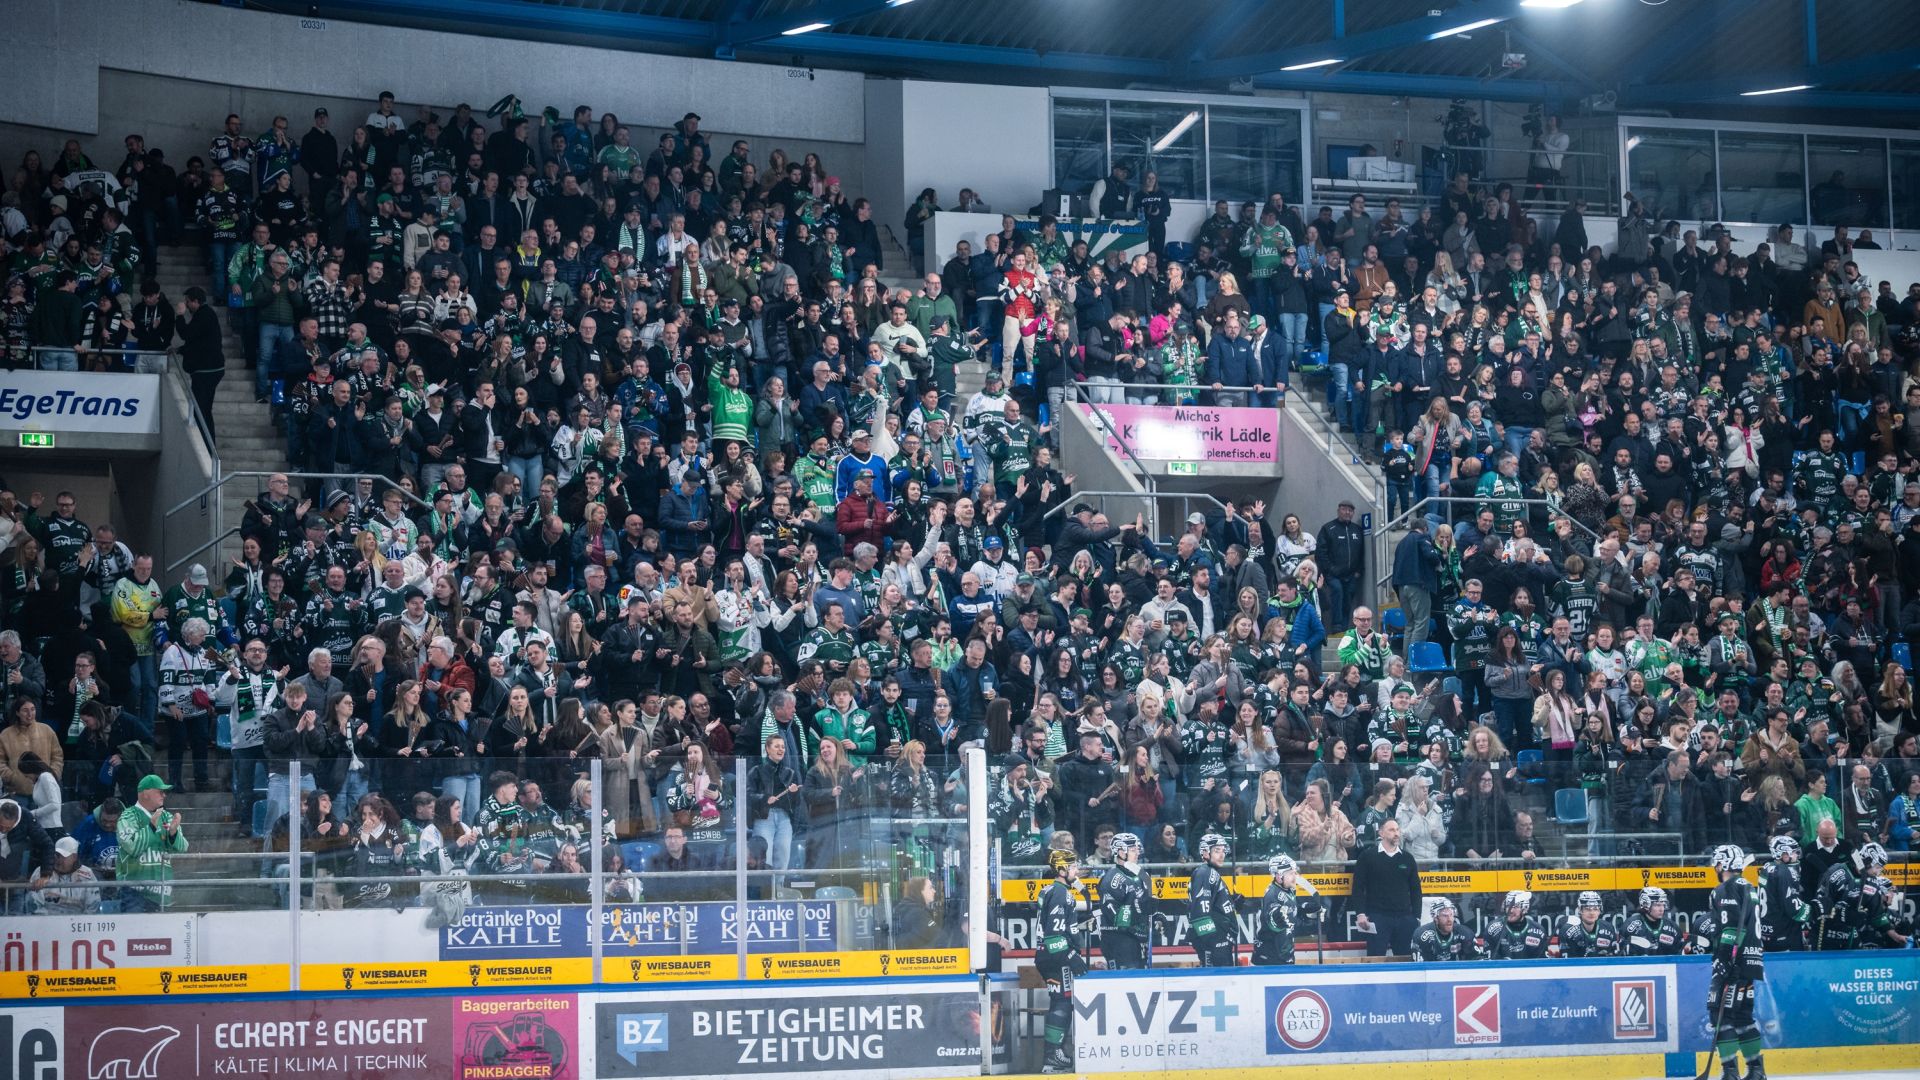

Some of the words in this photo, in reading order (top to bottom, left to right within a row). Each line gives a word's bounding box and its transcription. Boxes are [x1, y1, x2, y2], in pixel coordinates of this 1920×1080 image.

[301, 20, 326, 30] 12033/1
[0, 389, 140, 420] EgeTrans
[1174, 410, 1220, 422] Micha's
[1230, 427, 1271, 442] Lädle
[1420, 875, 1471, 883] WIESBAUER
[1655, 871, 1706, 879] WIESBAUER
[1308, 878, 1350, 886] ESBAUER
[1200, 901, 1210, 913] 15
[448, 909, 523, 927] etränke
[526, 909, 561, 926] Pool
[721, 905, 795, 922] Gtränke
[1720, 911, 1728, 924] 8
[71, 922, 94, 933] SEIT
[97, 922, 116, 932] 1919
[722, 919, 831, 940] KAHE
[1053, 919, 1066, 931] 24
[447, 926, 561, 945] KAHLE
[132, 942, 167, 952] Miele
[647, 961, 711, 970] WIESBAUER
[778, 959, 841, 968] WIESBAUER
[896, 956, 957, 964] WIESBAUER
[360, 969, 427, 979] WIESBAUER
[487, 966, 552, 976] WIESBAUER
[1854, 968, 1893, 979] DIESES
[45, 977, 116, 986] WIESBAUER
[178, 973, 248, 982] WIESBAUER
[1829, 982, 1874, 992] WASSER
[1878, 981, 1919, 991] BRINGT
[1856, 993, 1893, 1005] GLÜCK
[461, 998, 570, 1014] Baggerarbeiten
[1516, 1007, 1528, 1019] in
[1532, 1006, 1549, 1019] die
[1552, 1005, 1598, 1018] Zukunft
[692, 1005, 924, 1036] BIETIGHEIMER
[1344, 1013, 1366, 1025] Wir
[1369, 1012, 1405, 1024] bauen
[1408, 1011, 1442, 1025] Wege
[334, 1018, 428, 1045] ENGERT
[1287, 1020, 1321, 1031] BAU
[623, 1019, 663, 1045] BZ
[1456, 1034, 1499, 1043] KLÖPFER
[738, 1035, 884, 1064] ZEITUNG
[936, 1045, 966, 1057] Ganz
[1078, 1045, 1111, 1059] EAM
[1121, 1043, 1199, 1058] BUDERER
[215, 1056, 268, 1074] KÄLTE
[285, 1057, 338, 1072] KLIMA
[355, 1054, 428, 1070] TECHNIK
[464, 1066, 551, 1079] PINKBAGGER
